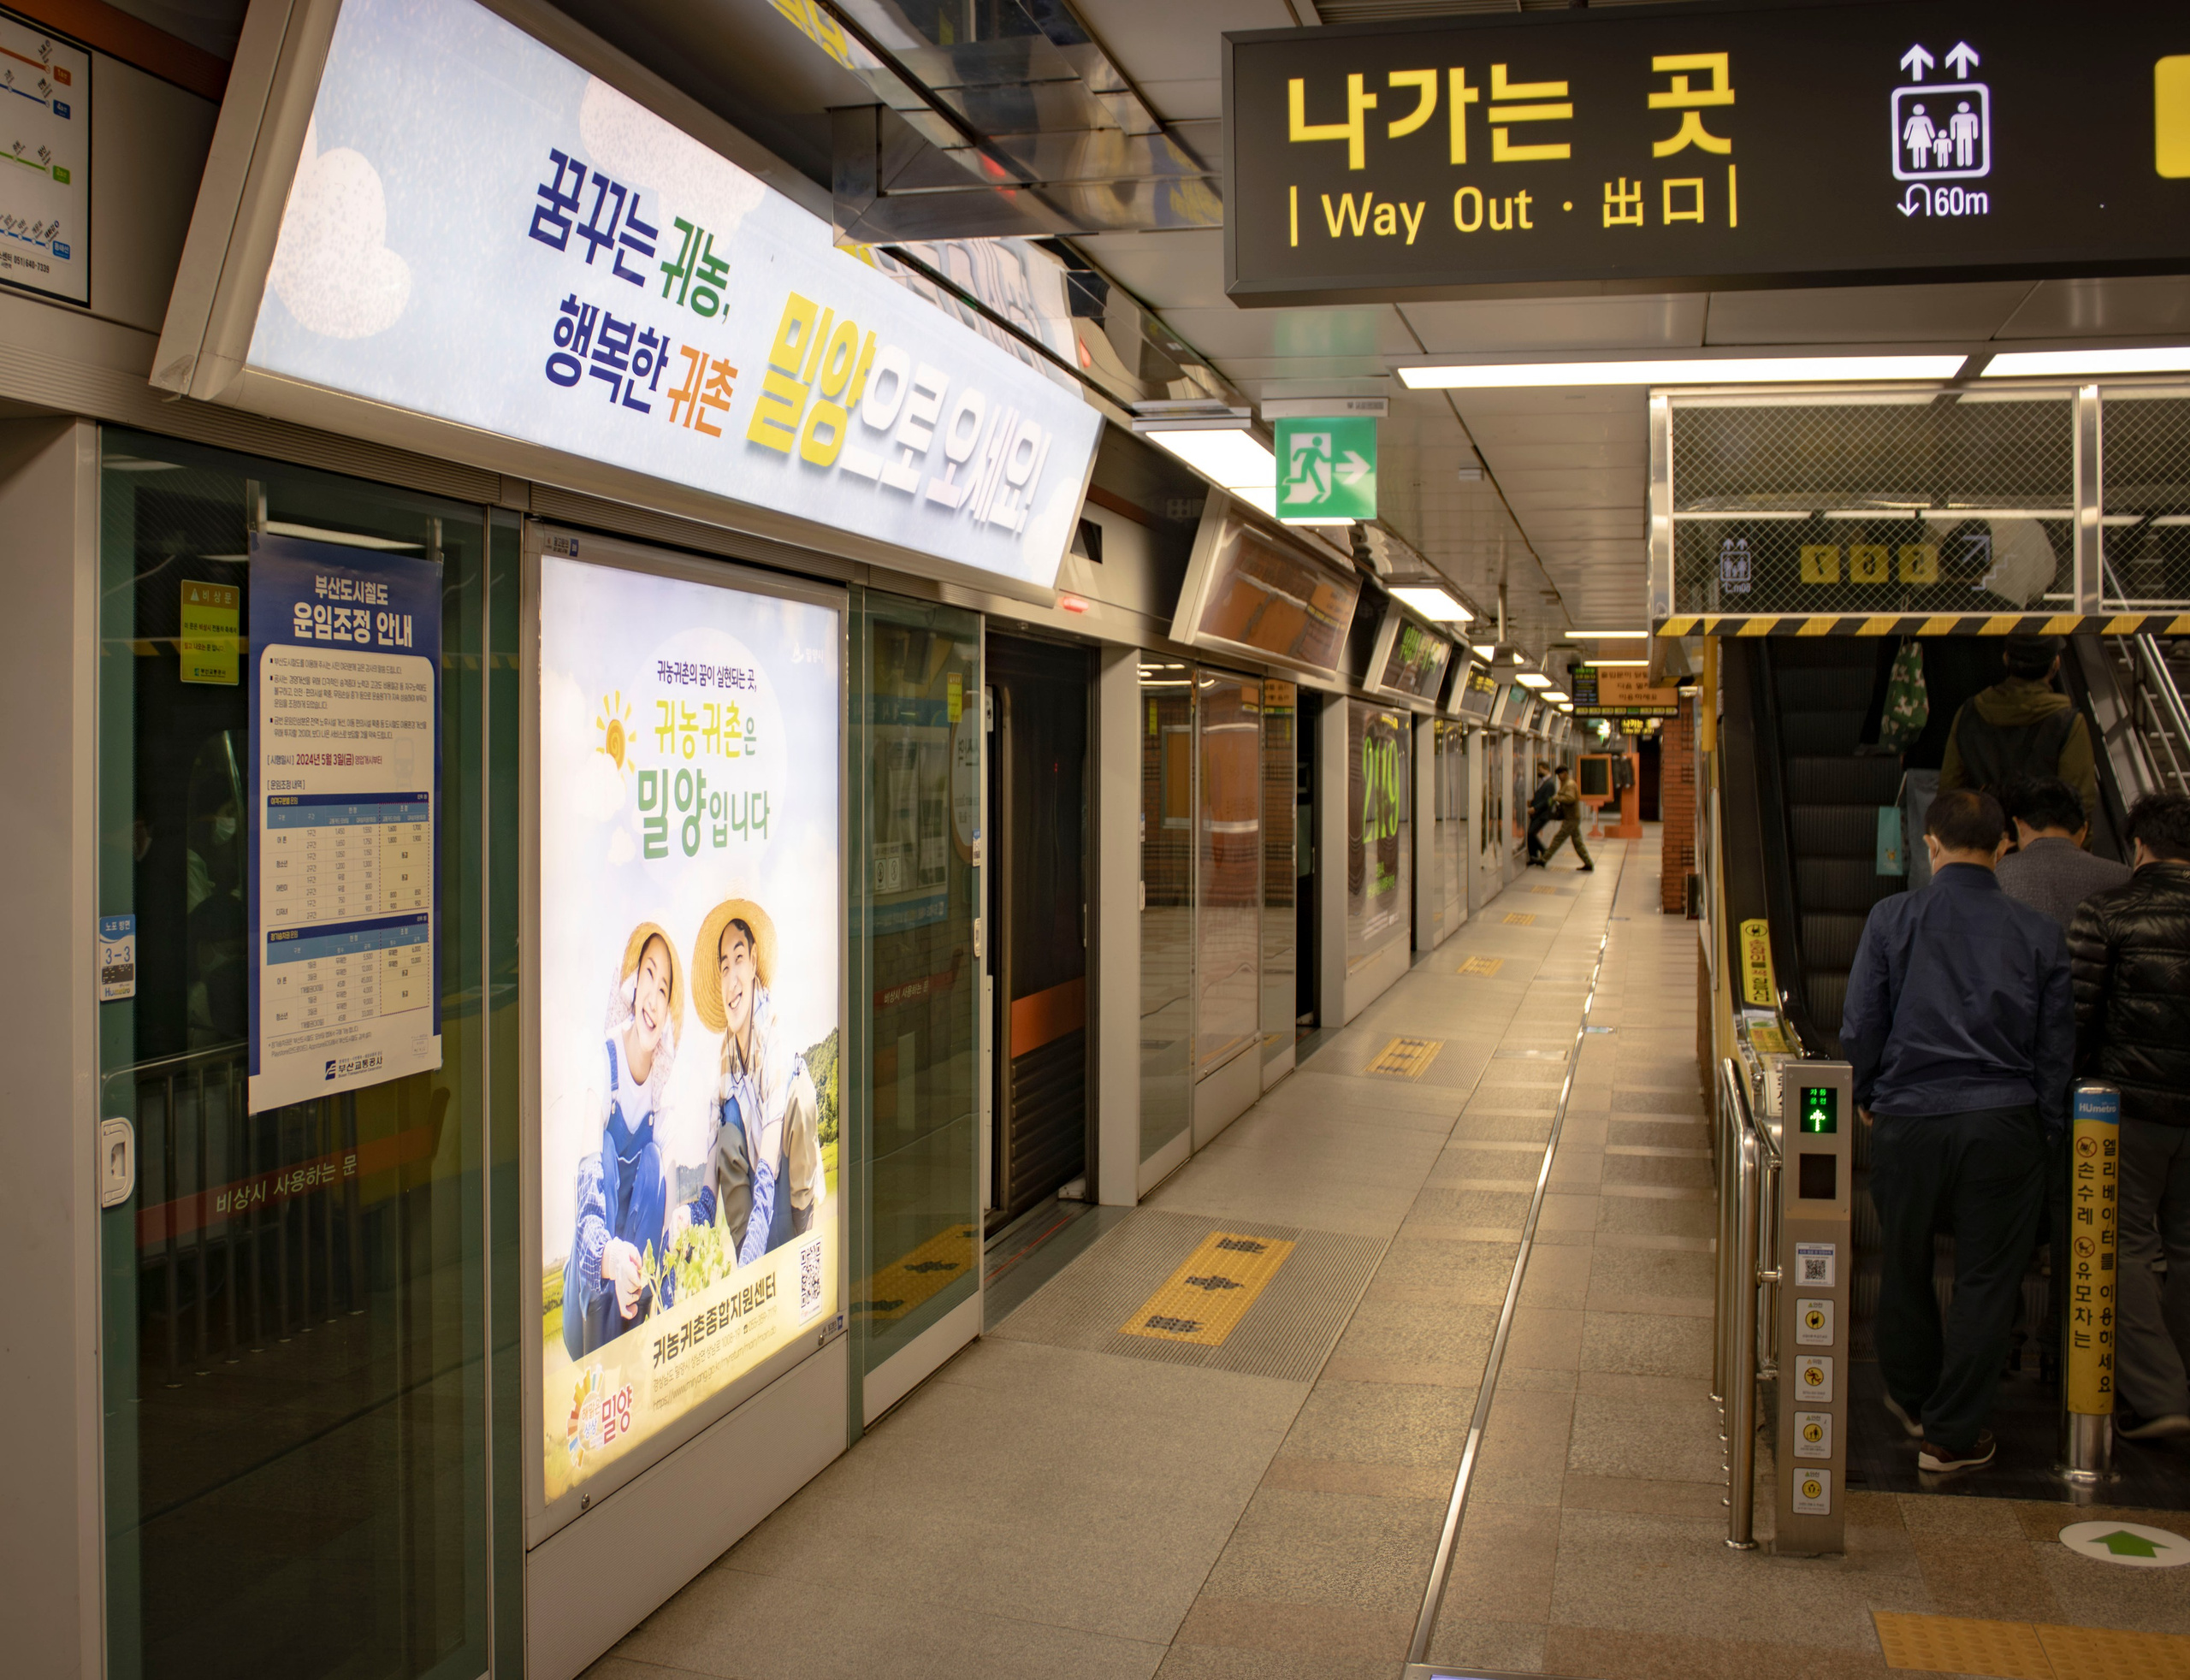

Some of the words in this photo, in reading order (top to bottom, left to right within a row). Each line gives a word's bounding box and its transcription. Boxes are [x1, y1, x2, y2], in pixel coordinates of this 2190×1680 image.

[1287, 61, 1574, 171] 나가는
[1647, 50, 1735, 160] 곳
[1322, 191, 1427, 246] Way
[1453, 186, 1534, 233] Out
[1933, 186, 1989, 218] 60m
[528, 148, 659, 288] 꿈꾸는
[660, 215, 731, 325] 귀농,
[544, 293, 671, 414] 행복한
[666, 343, 738, 438] 귀촌
[745, 291, 951, 495] 밀양으로
[314, 575, 388, 606] 부산도시철도
[293, 601, 370, 643] 운임조정
[376, 612, 412, 648] 안내
[657, 660, 697, 685] 귀농귀촌의
[699, 663, 715, 686] 꿈이
[716, 665, 746, 690] 실현되는
[747, 669, 757, 692] 곳,
[296, 754, 320, 766] 2024년
[322, 754, 332, 766] 5월
[333, 754, 354, 766] 3일(금)
[654, 699, 757, 760] 귀농귀촌은
[637, 768, 770, 860] 밀양입니다
[105, 945, 131, 964] 3-3
[338, 1056, 382, 1073] 부산교통공사
[216, 1180, 266, 1214] 비상시
[274, 1162, 336, 1200] 사용하는
[342, 1154, 358, 1176] 문
[2076, 1162, 2095, 1227] 손수레
[2100, 1138, 2117, 1271] 엘리베이터를
[653, 1271, 776, 1369] 귀농귀촌종합지원센터
[2074, 1261, 2093, 1350] 유모차는
[2098, 1284, 2114, 1394] 이용하세요
[601, 1385, 632, 1445] 밀양
